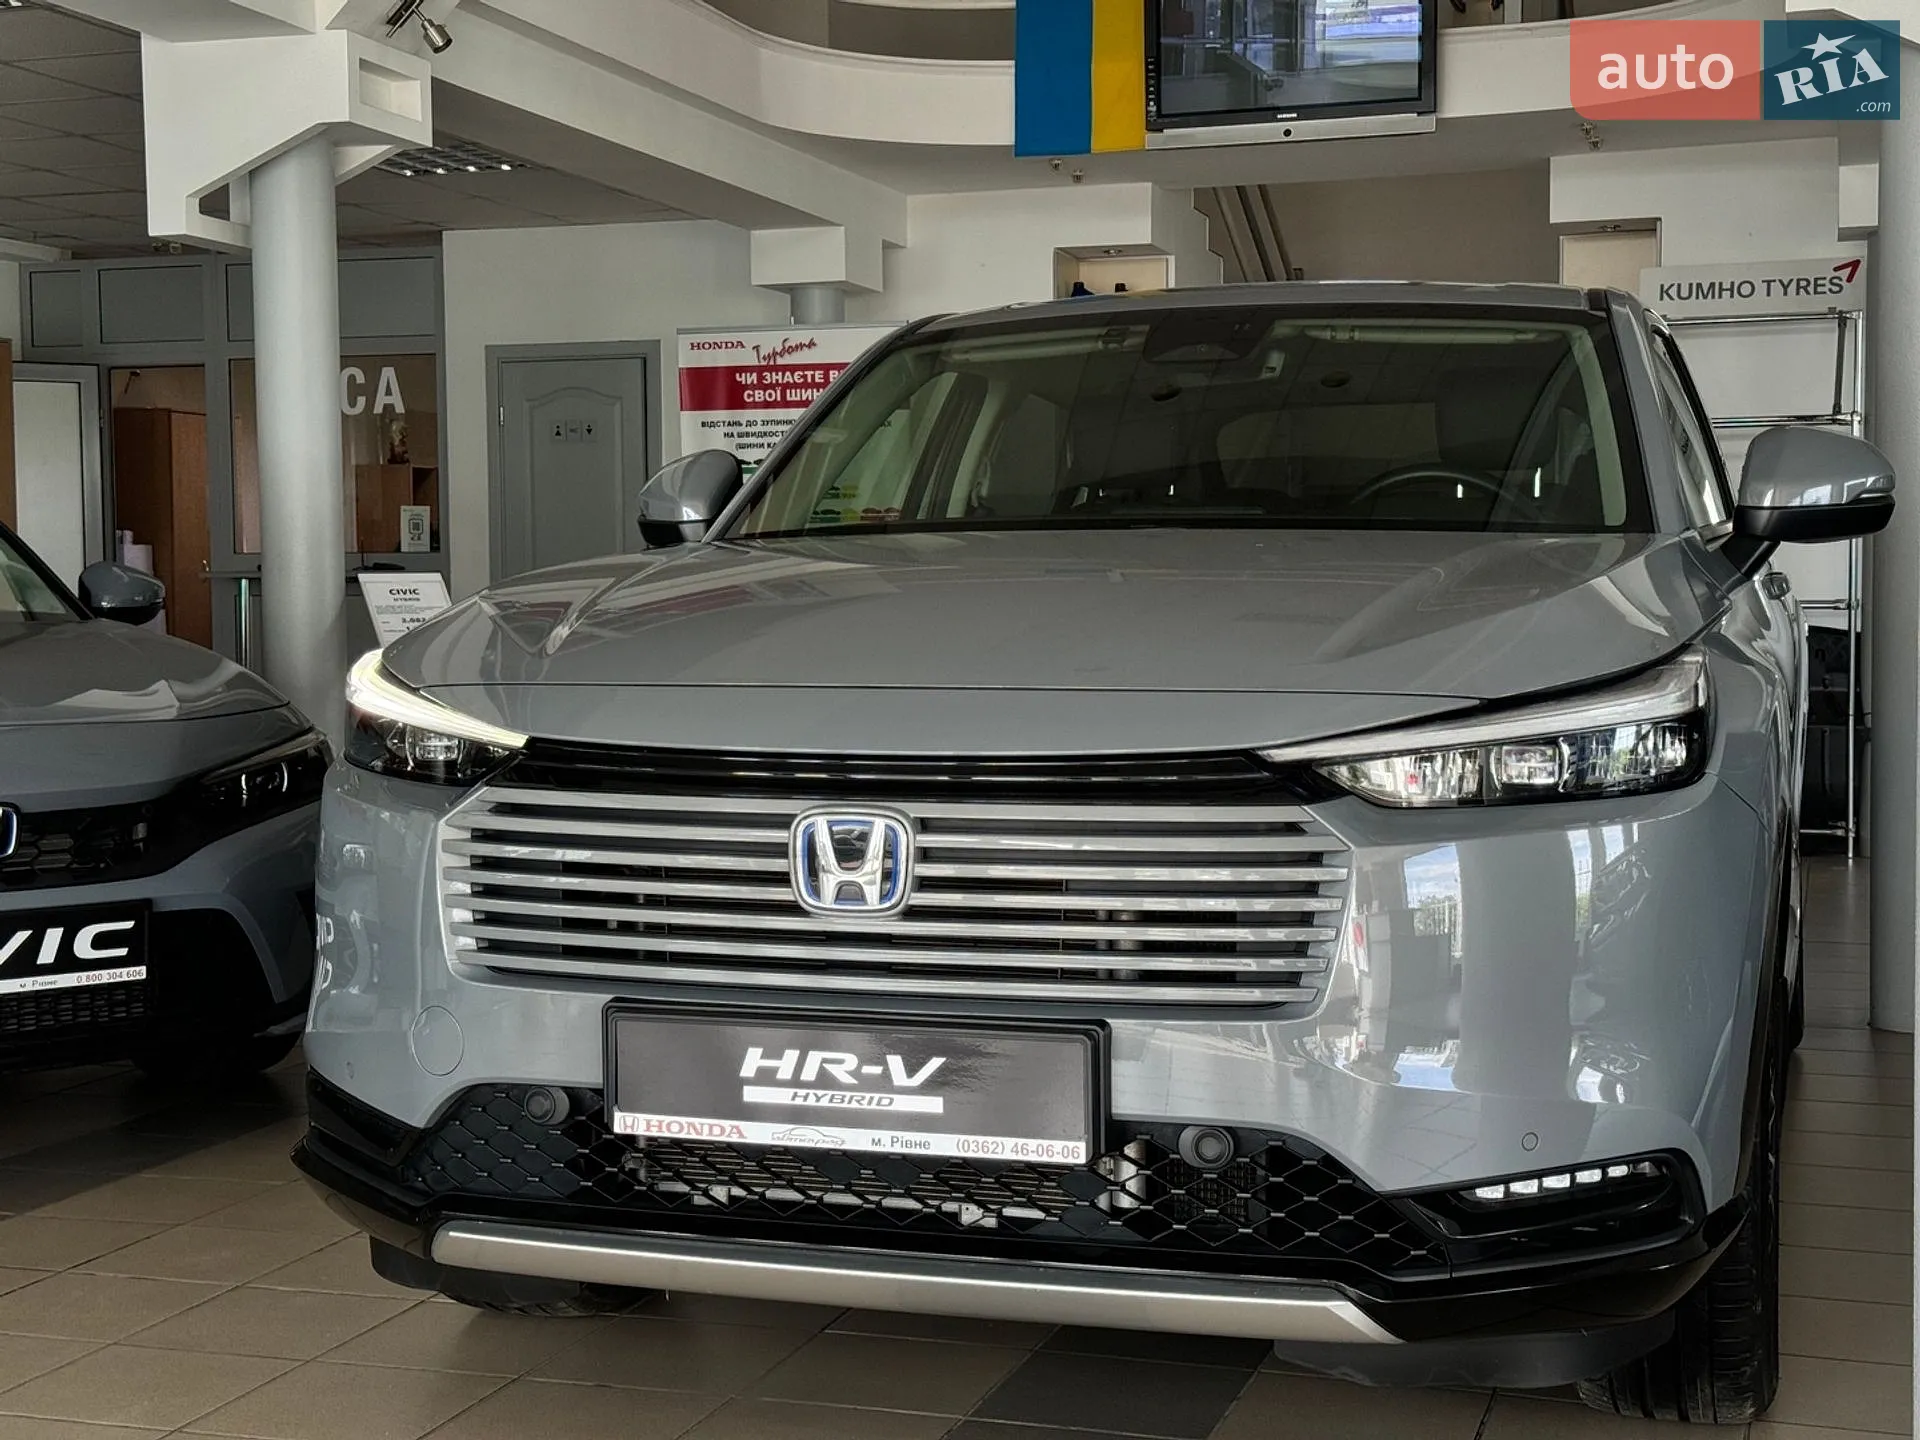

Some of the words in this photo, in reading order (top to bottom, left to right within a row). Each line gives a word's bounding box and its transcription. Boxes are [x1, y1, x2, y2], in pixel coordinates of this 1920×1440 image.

[1658, 280, 1756, 302] KUMHO
[1761, 276, 1844, 297] TYRES
[689, 340, 746, 351] HONDA
[752, 337, 817, 366] Турбота
[735, 372, 758, 385] ЧИ
[761, 370, 825, 385] ЗНАЄТЕ
[743, 387, 782, 403] СВОЇ
[701, 420, 743, 429] ВІДСТАНЬ
[745, 419, 758, 428] ДО
[723, 431, 735, 439] НА
[389, 588, 420, 596] CIVIC
[739, 1047, 947, 1087] HR-V
[790, 1091, 895, 1107] HYBRID
[643, 1118, 747, 1139] HONDA
[870, 1137, 886, 1148] м.
[890, 1135, 931, 1150] Рівне
[955, 1137, 1006, 1154] (0362)
[1010, 1142, 1081, 1159] 46-06-06
